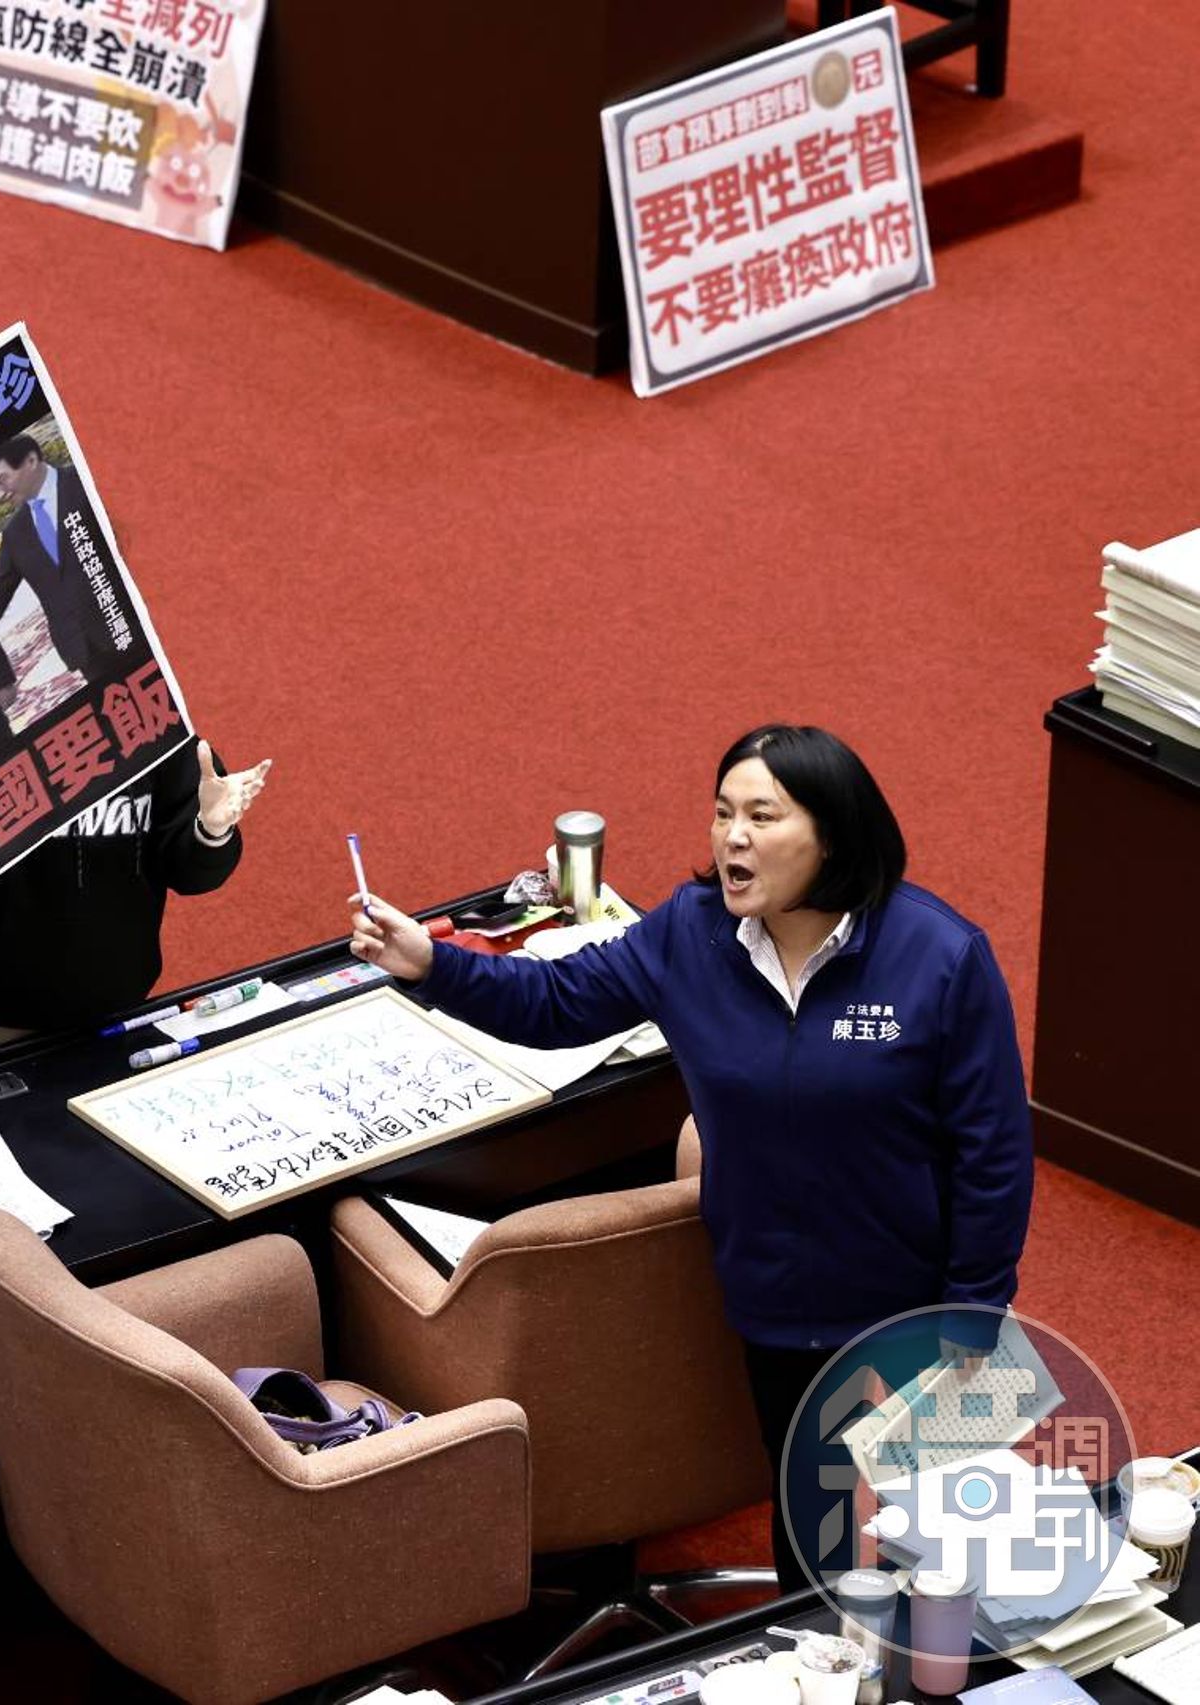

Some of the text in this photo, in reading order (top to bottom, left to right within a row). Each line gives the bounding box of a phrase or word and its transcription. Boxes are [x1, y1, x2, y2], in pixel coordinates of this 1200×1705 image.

[852, 48, 884, 93] 元
[634, 107, 899, 272] 要理性監督
[647, 201, 912, 347] 不要癱瘓政府
[832, 1019, 902, 1042] 陳玉珍
[846, 1003, 894, 1017] 立法委員
